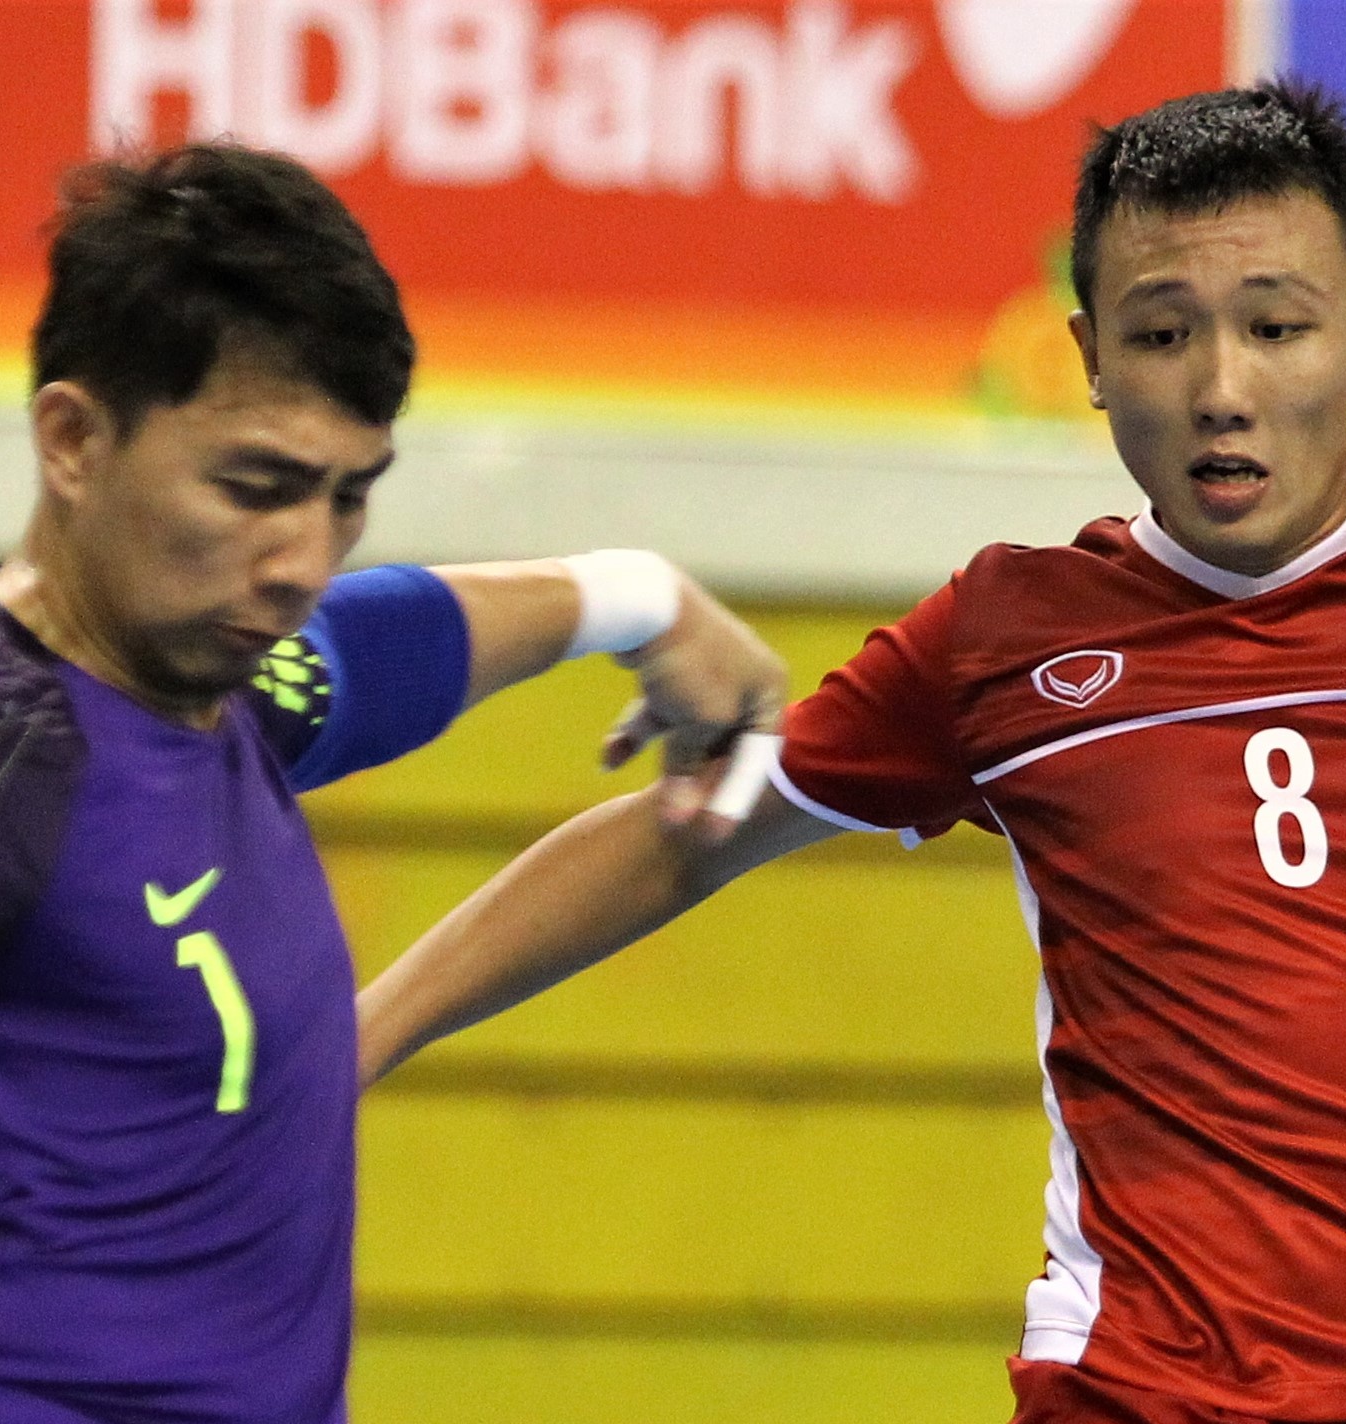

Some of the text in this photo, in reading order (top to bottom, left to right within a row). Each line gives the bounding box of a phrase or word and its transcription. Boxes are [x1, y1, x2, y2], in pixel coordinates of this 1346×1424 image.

[86, 0, 919, 202] HDBank
[1243, 726, 1329, 888] 8
[175, 930, 257, 1115] 1
